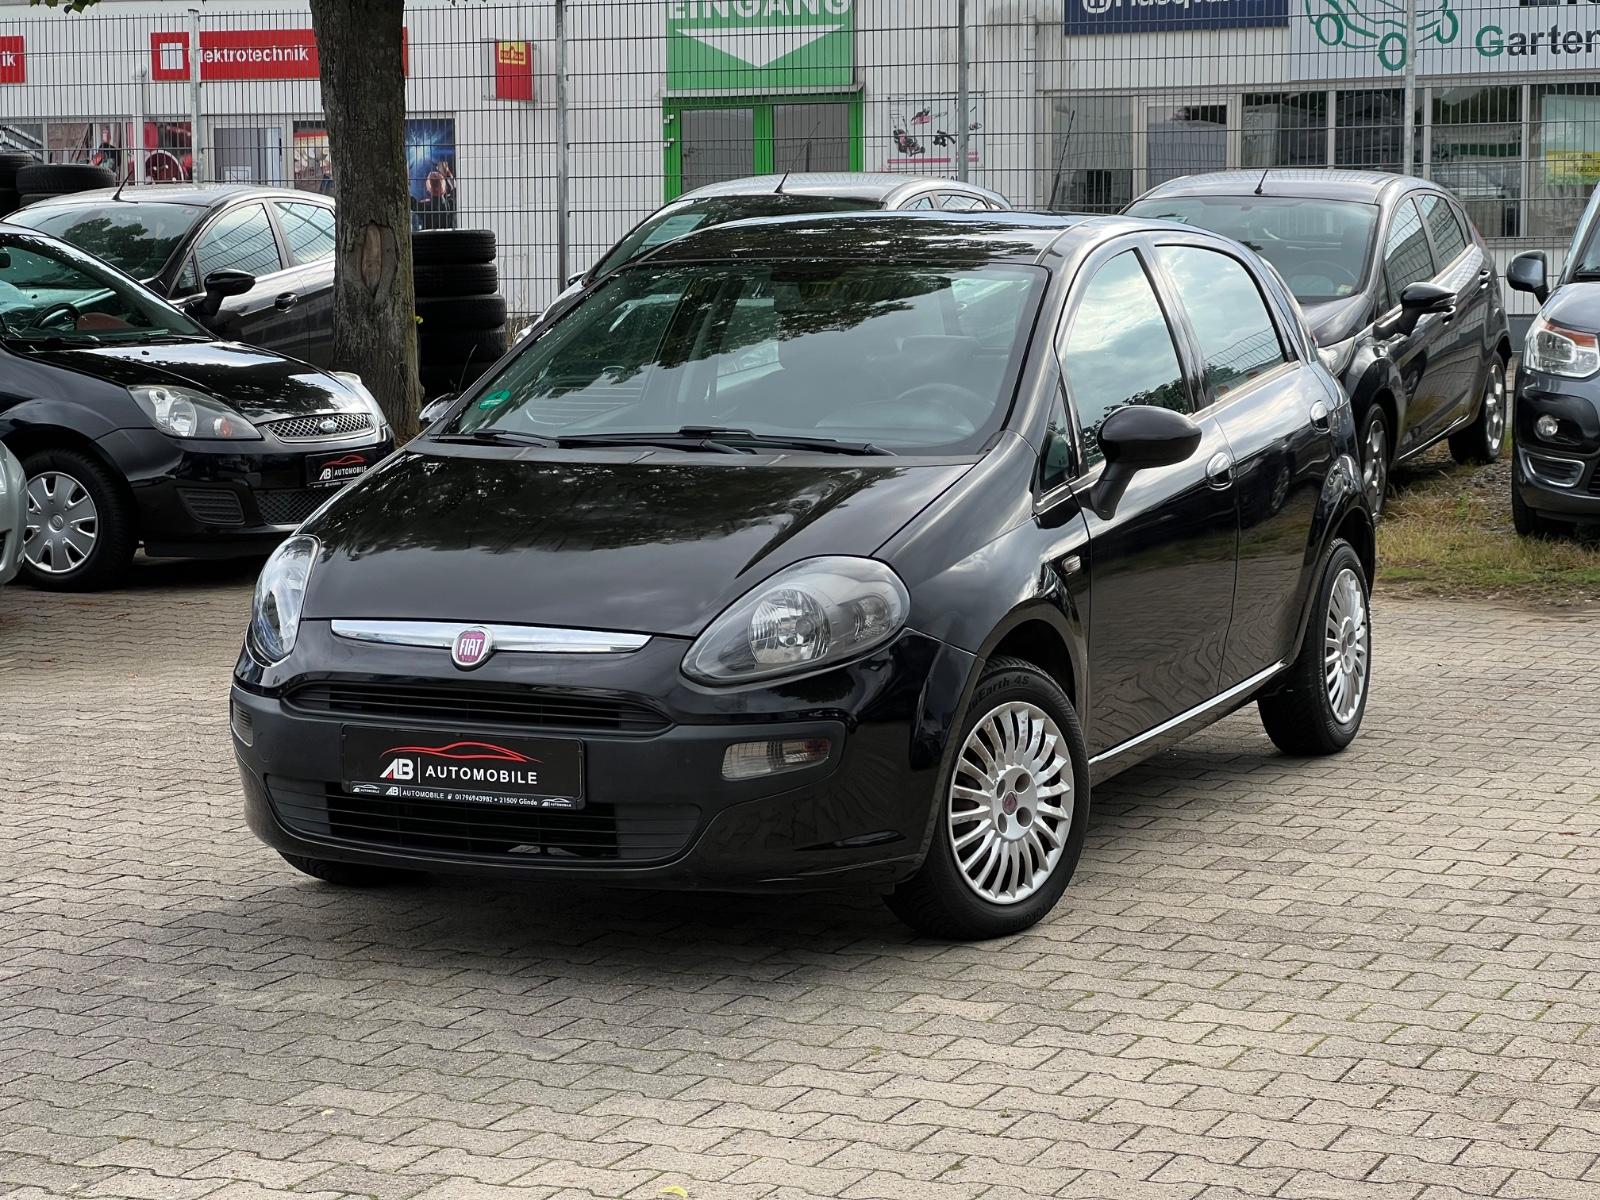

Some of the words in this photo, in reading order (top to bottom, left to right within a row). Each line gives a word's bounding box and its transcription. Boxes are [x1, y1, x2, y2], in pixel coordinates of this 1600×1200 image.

[188, 44, 309, 63] lektrotechnik
[459, 638, 483, 656] FIAT
[380, 758, 414, 780] AB
[425, 765, 538, 784] AUTOMOBILE
[385, 786, 399, 796] AB
[402, 790, 444, 799] AUTOMOBILE
[499, 796, 518, 804] 21509
[518, 798, 538, 806] Glinde
